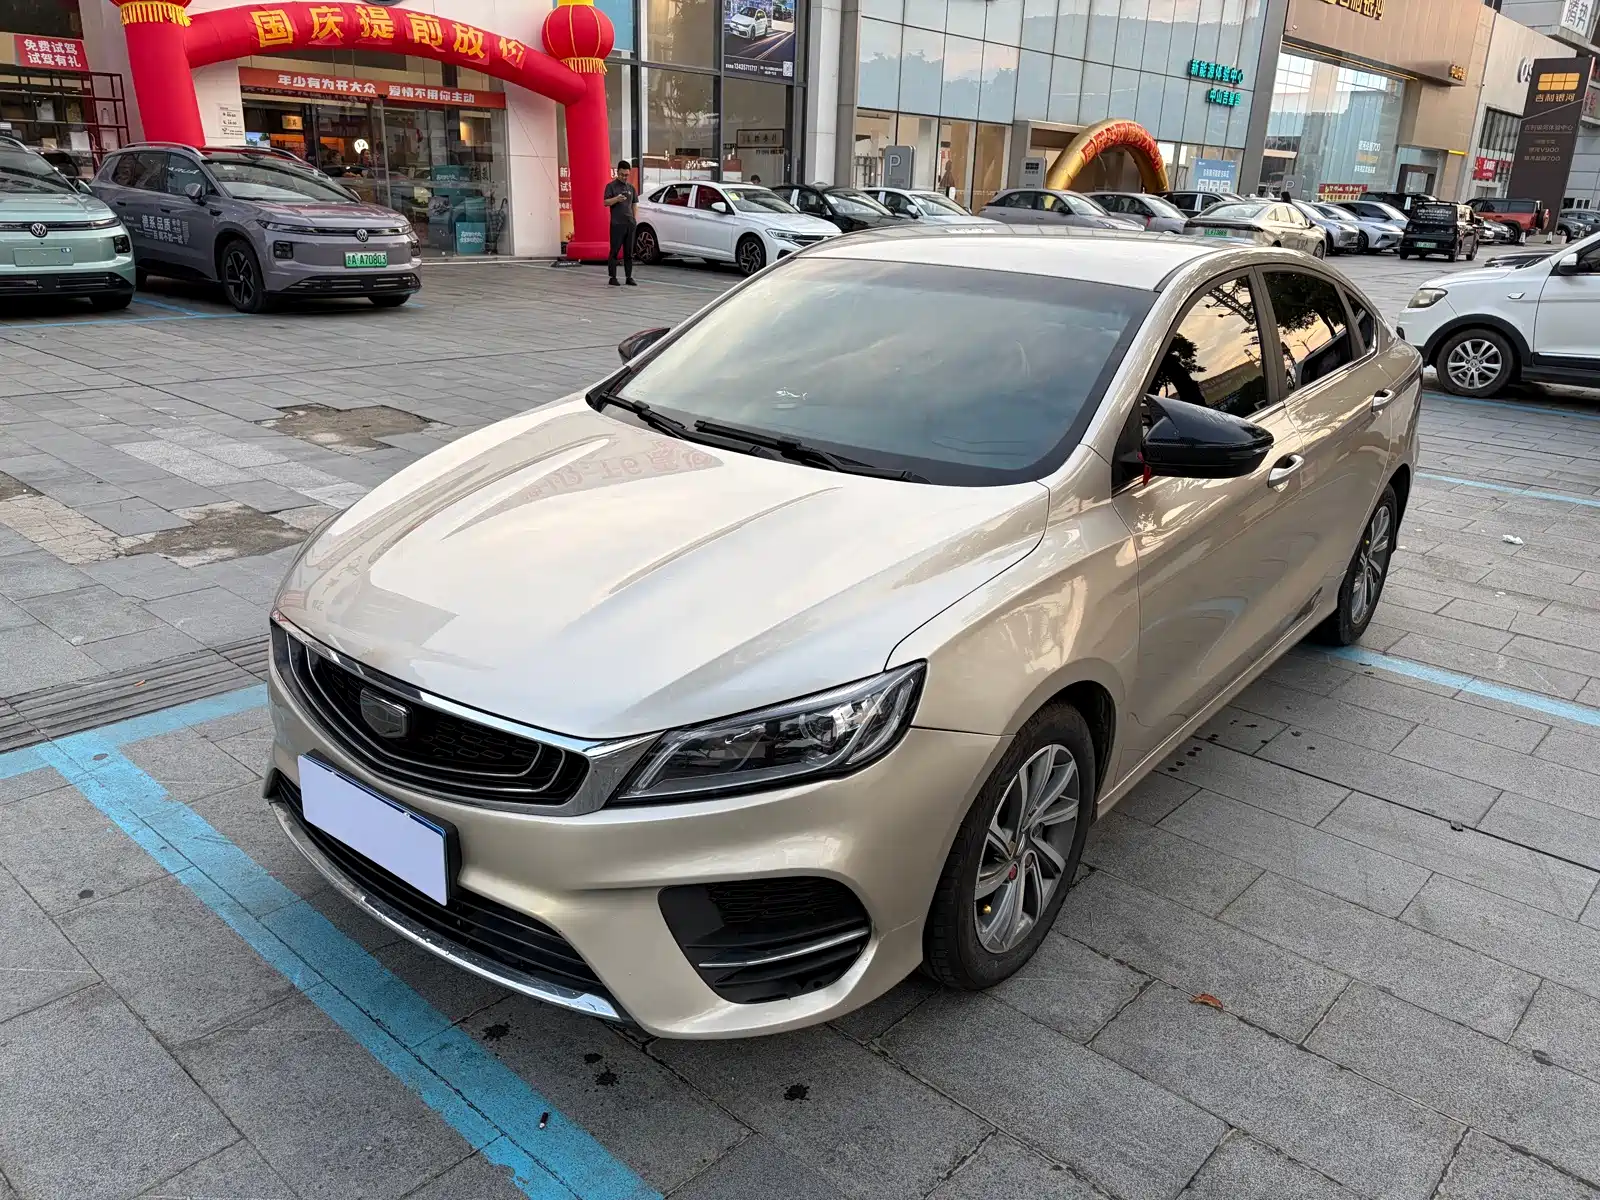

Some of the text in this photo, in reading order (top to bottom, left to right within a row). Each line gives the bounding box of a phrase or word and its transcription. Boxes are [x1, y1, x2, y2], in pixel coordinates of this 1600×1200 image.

[24, 38, 78, 55] 免费试驾
[250, 5, 526, 69] 国庆提前放价
[27, 52, 82, 67] 试驾有礼
[1190, 59, 1244, 84] 新能源体验中心
[277, 74, 476, 104] 年少有为开大众 爱情不用你主动
[1535, 94, 1576, 103] 吉利银河
